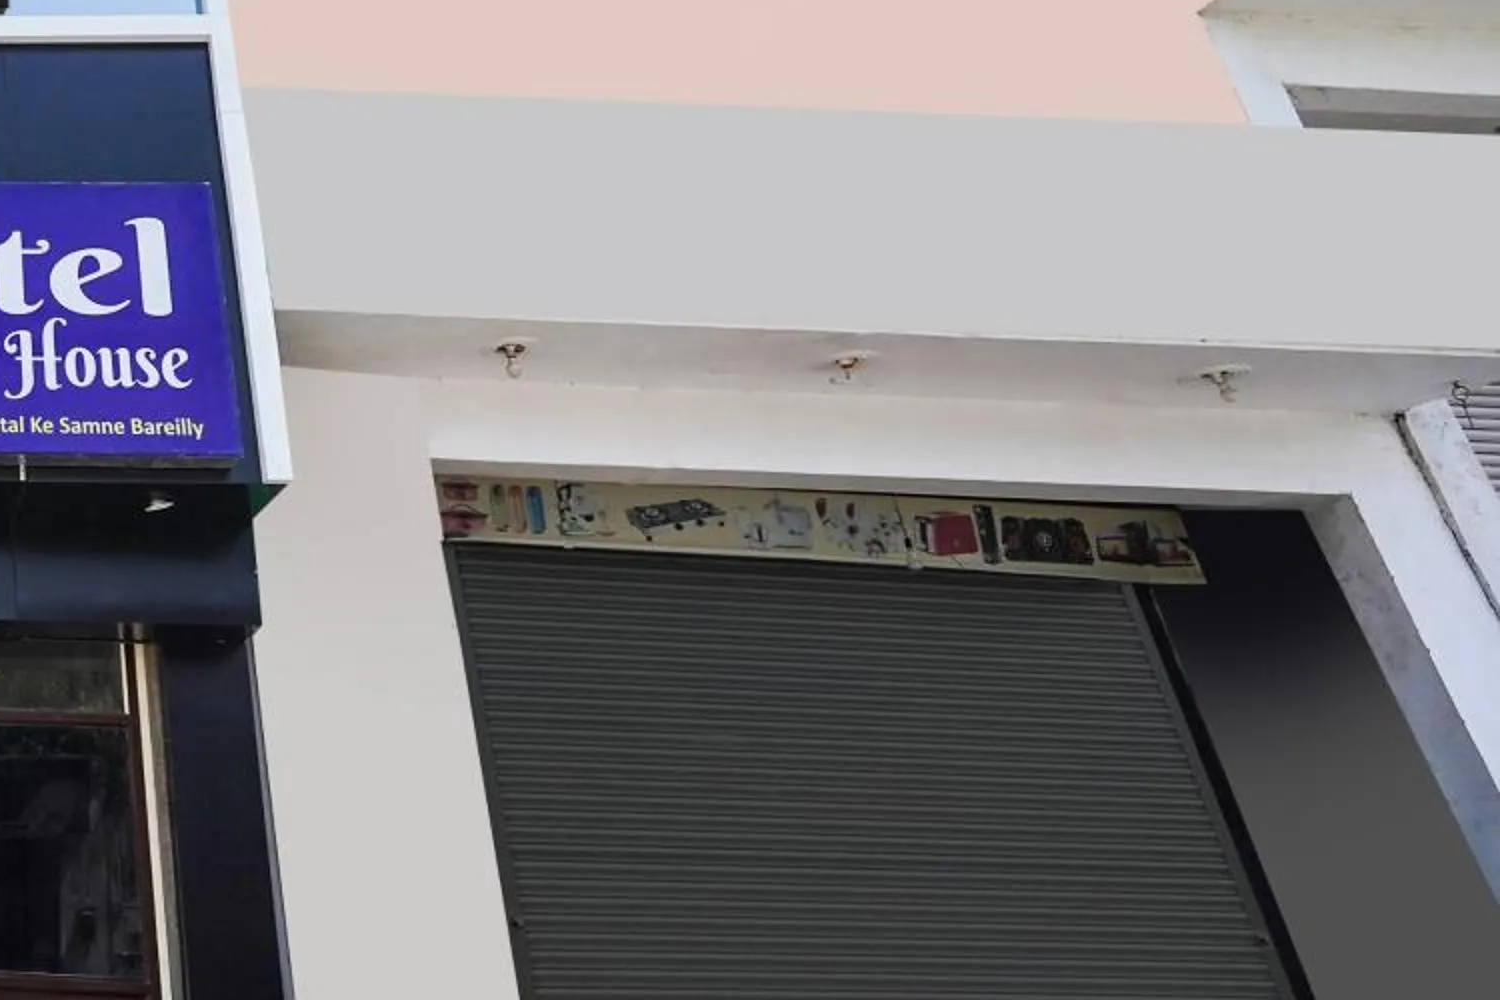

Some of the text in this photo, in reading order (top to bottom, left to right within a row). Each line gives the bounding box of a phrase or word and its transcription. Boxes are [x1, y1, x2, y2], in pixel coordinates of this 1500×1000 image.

[3, 316, 193, 400] House
[29, 416, 55, 435] Ke
[59, 416, 125, 436] Samne
[130, 417, 204, 441] Bareilly
